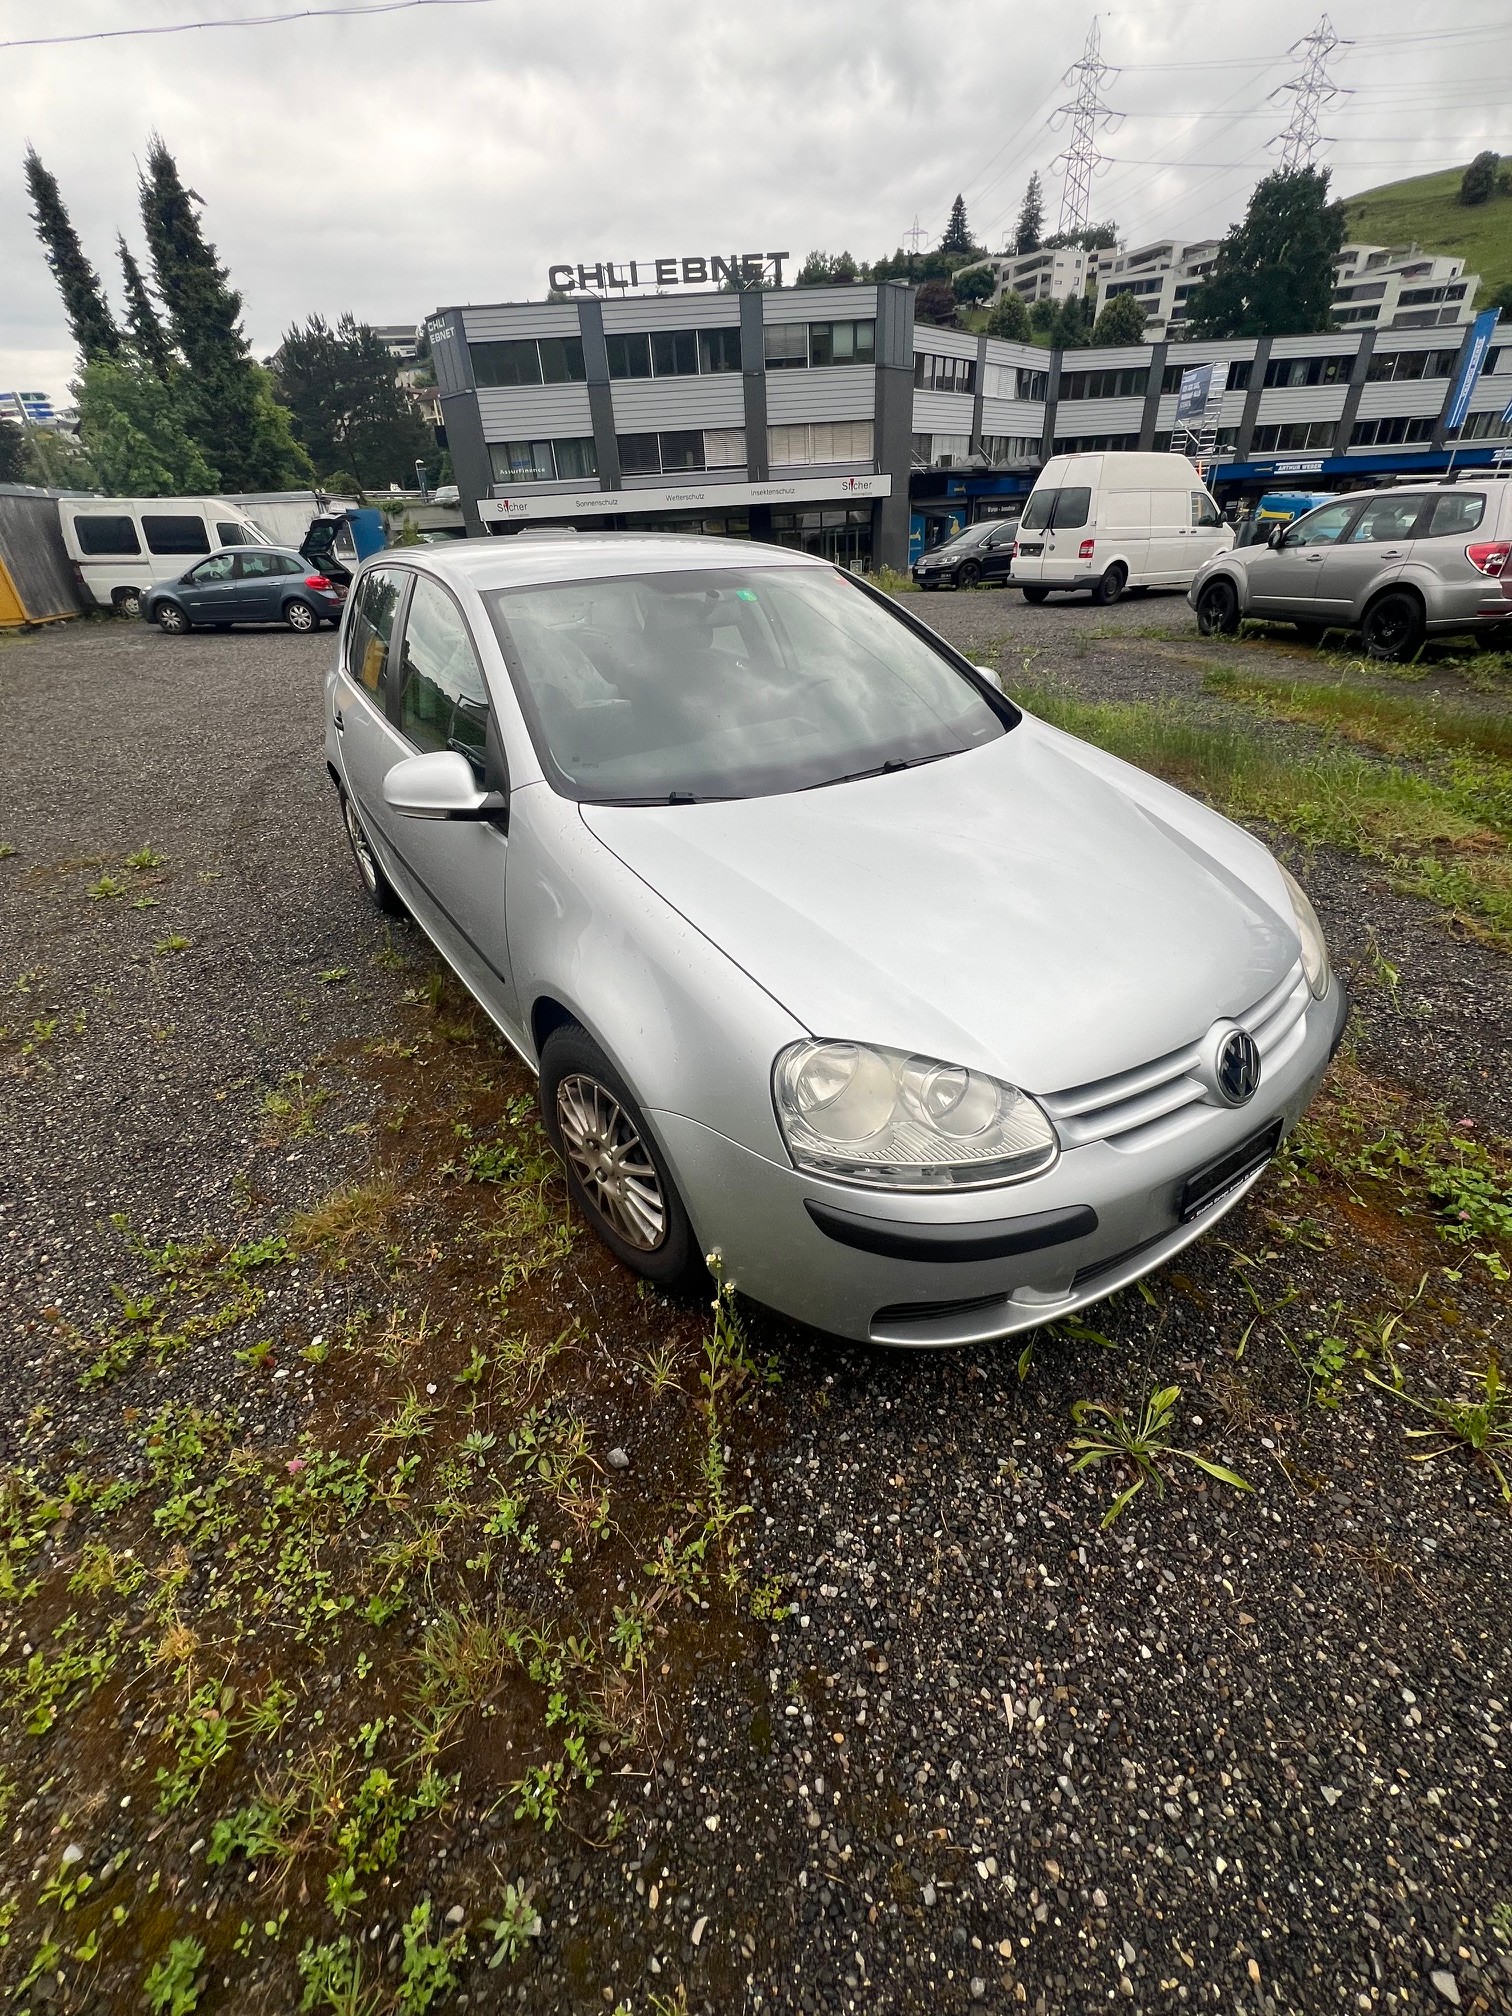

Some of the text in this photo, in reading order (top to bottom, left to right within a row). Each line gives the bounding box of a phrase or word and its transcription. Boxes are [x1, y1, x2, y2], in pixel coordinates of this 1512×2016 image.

[548, 251, 790, 291] CHLI EBNET
[427, 317, 446, 332] CHLI
[430, 326, 455, 344] EBNET
[665, 493, 705, 502] Wetterschutz
[751, 487, 795, 497] Insektenschutz
[575, 499, 618, 508] Sonnenschutz
